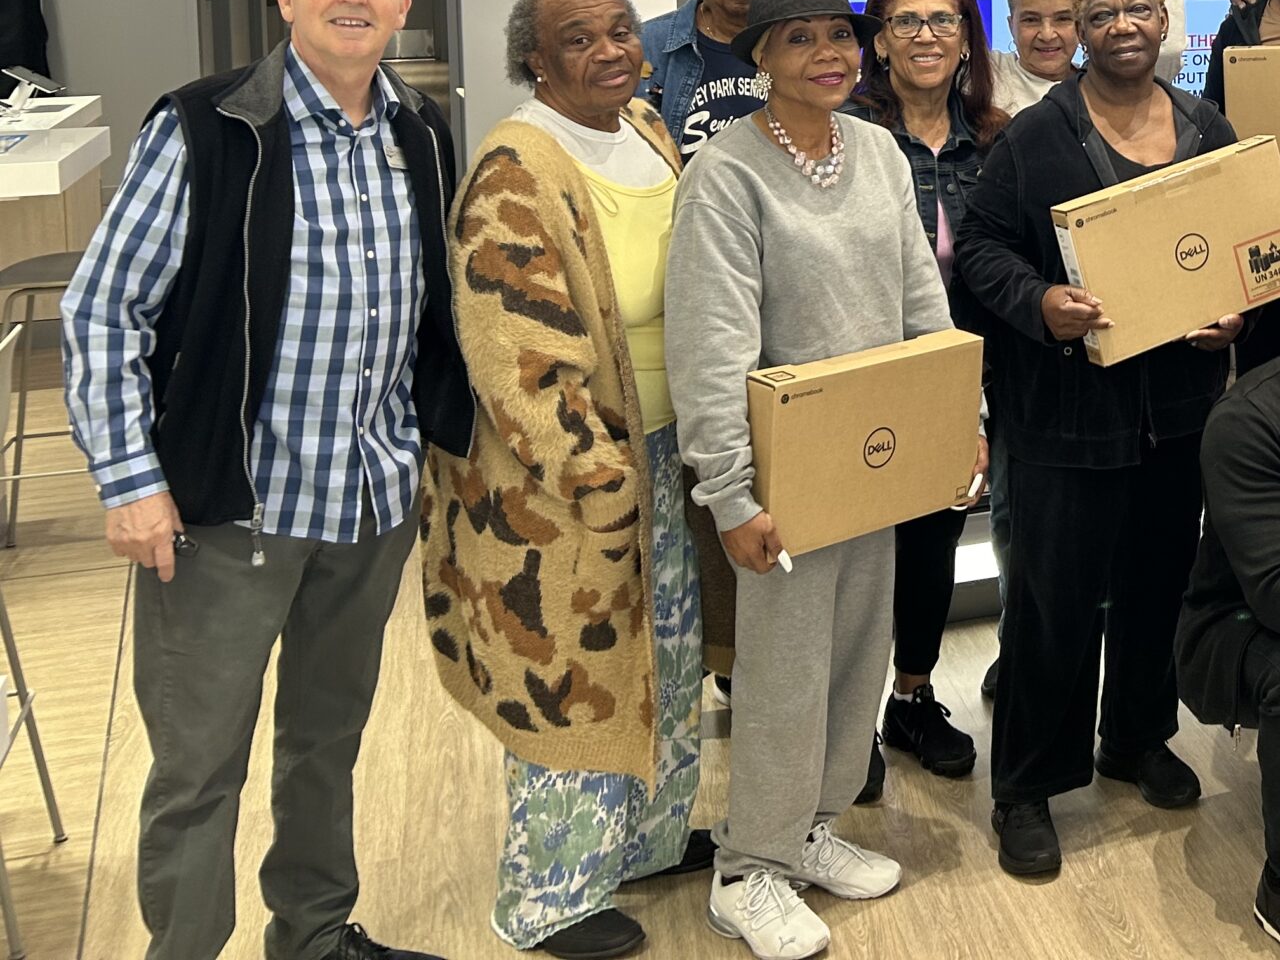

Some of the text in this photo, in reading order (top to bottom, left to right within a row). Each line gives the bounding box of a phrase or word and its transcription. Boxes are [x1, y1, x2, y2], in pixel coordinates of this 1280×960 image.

[1173, 71, 1208, 85] PUT
[708, 77, 736, 100] PARK
[1179, 244, 1206, 262] DELL
[1254, 272, 1268, 285] UN
[867, 442, 893, 456] DELL
